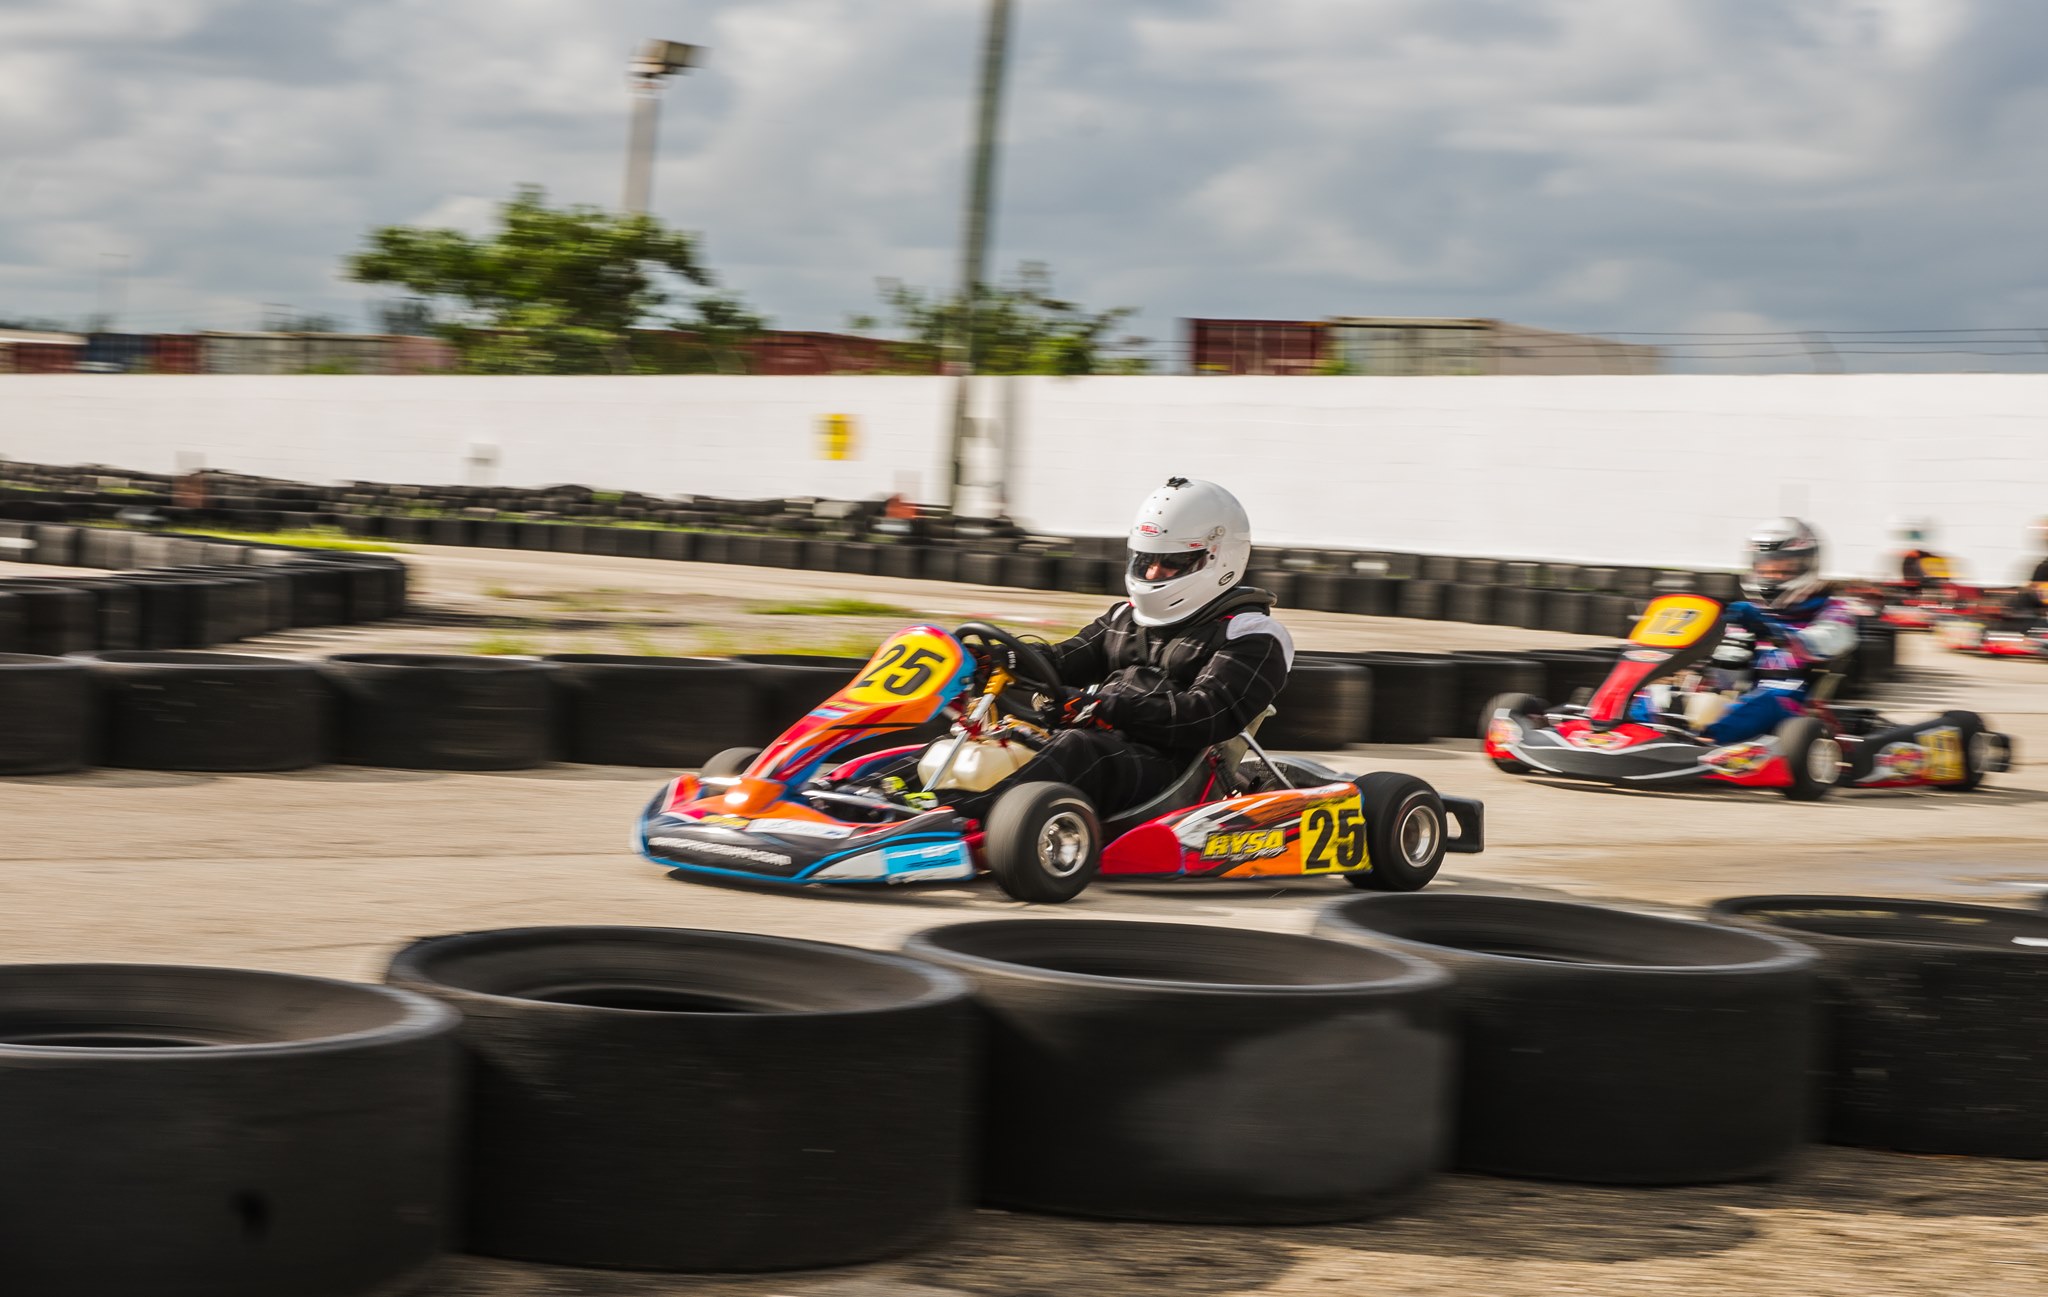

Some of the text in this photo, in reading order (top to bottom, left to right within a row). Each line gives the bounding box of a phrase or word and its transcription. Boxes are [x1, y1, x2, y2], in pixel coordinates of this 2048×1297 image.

[855, 644, 945, 696] 25
[1204, 831, 1285, 857] RYSA
[1306, 809, 1367, 869] 25
